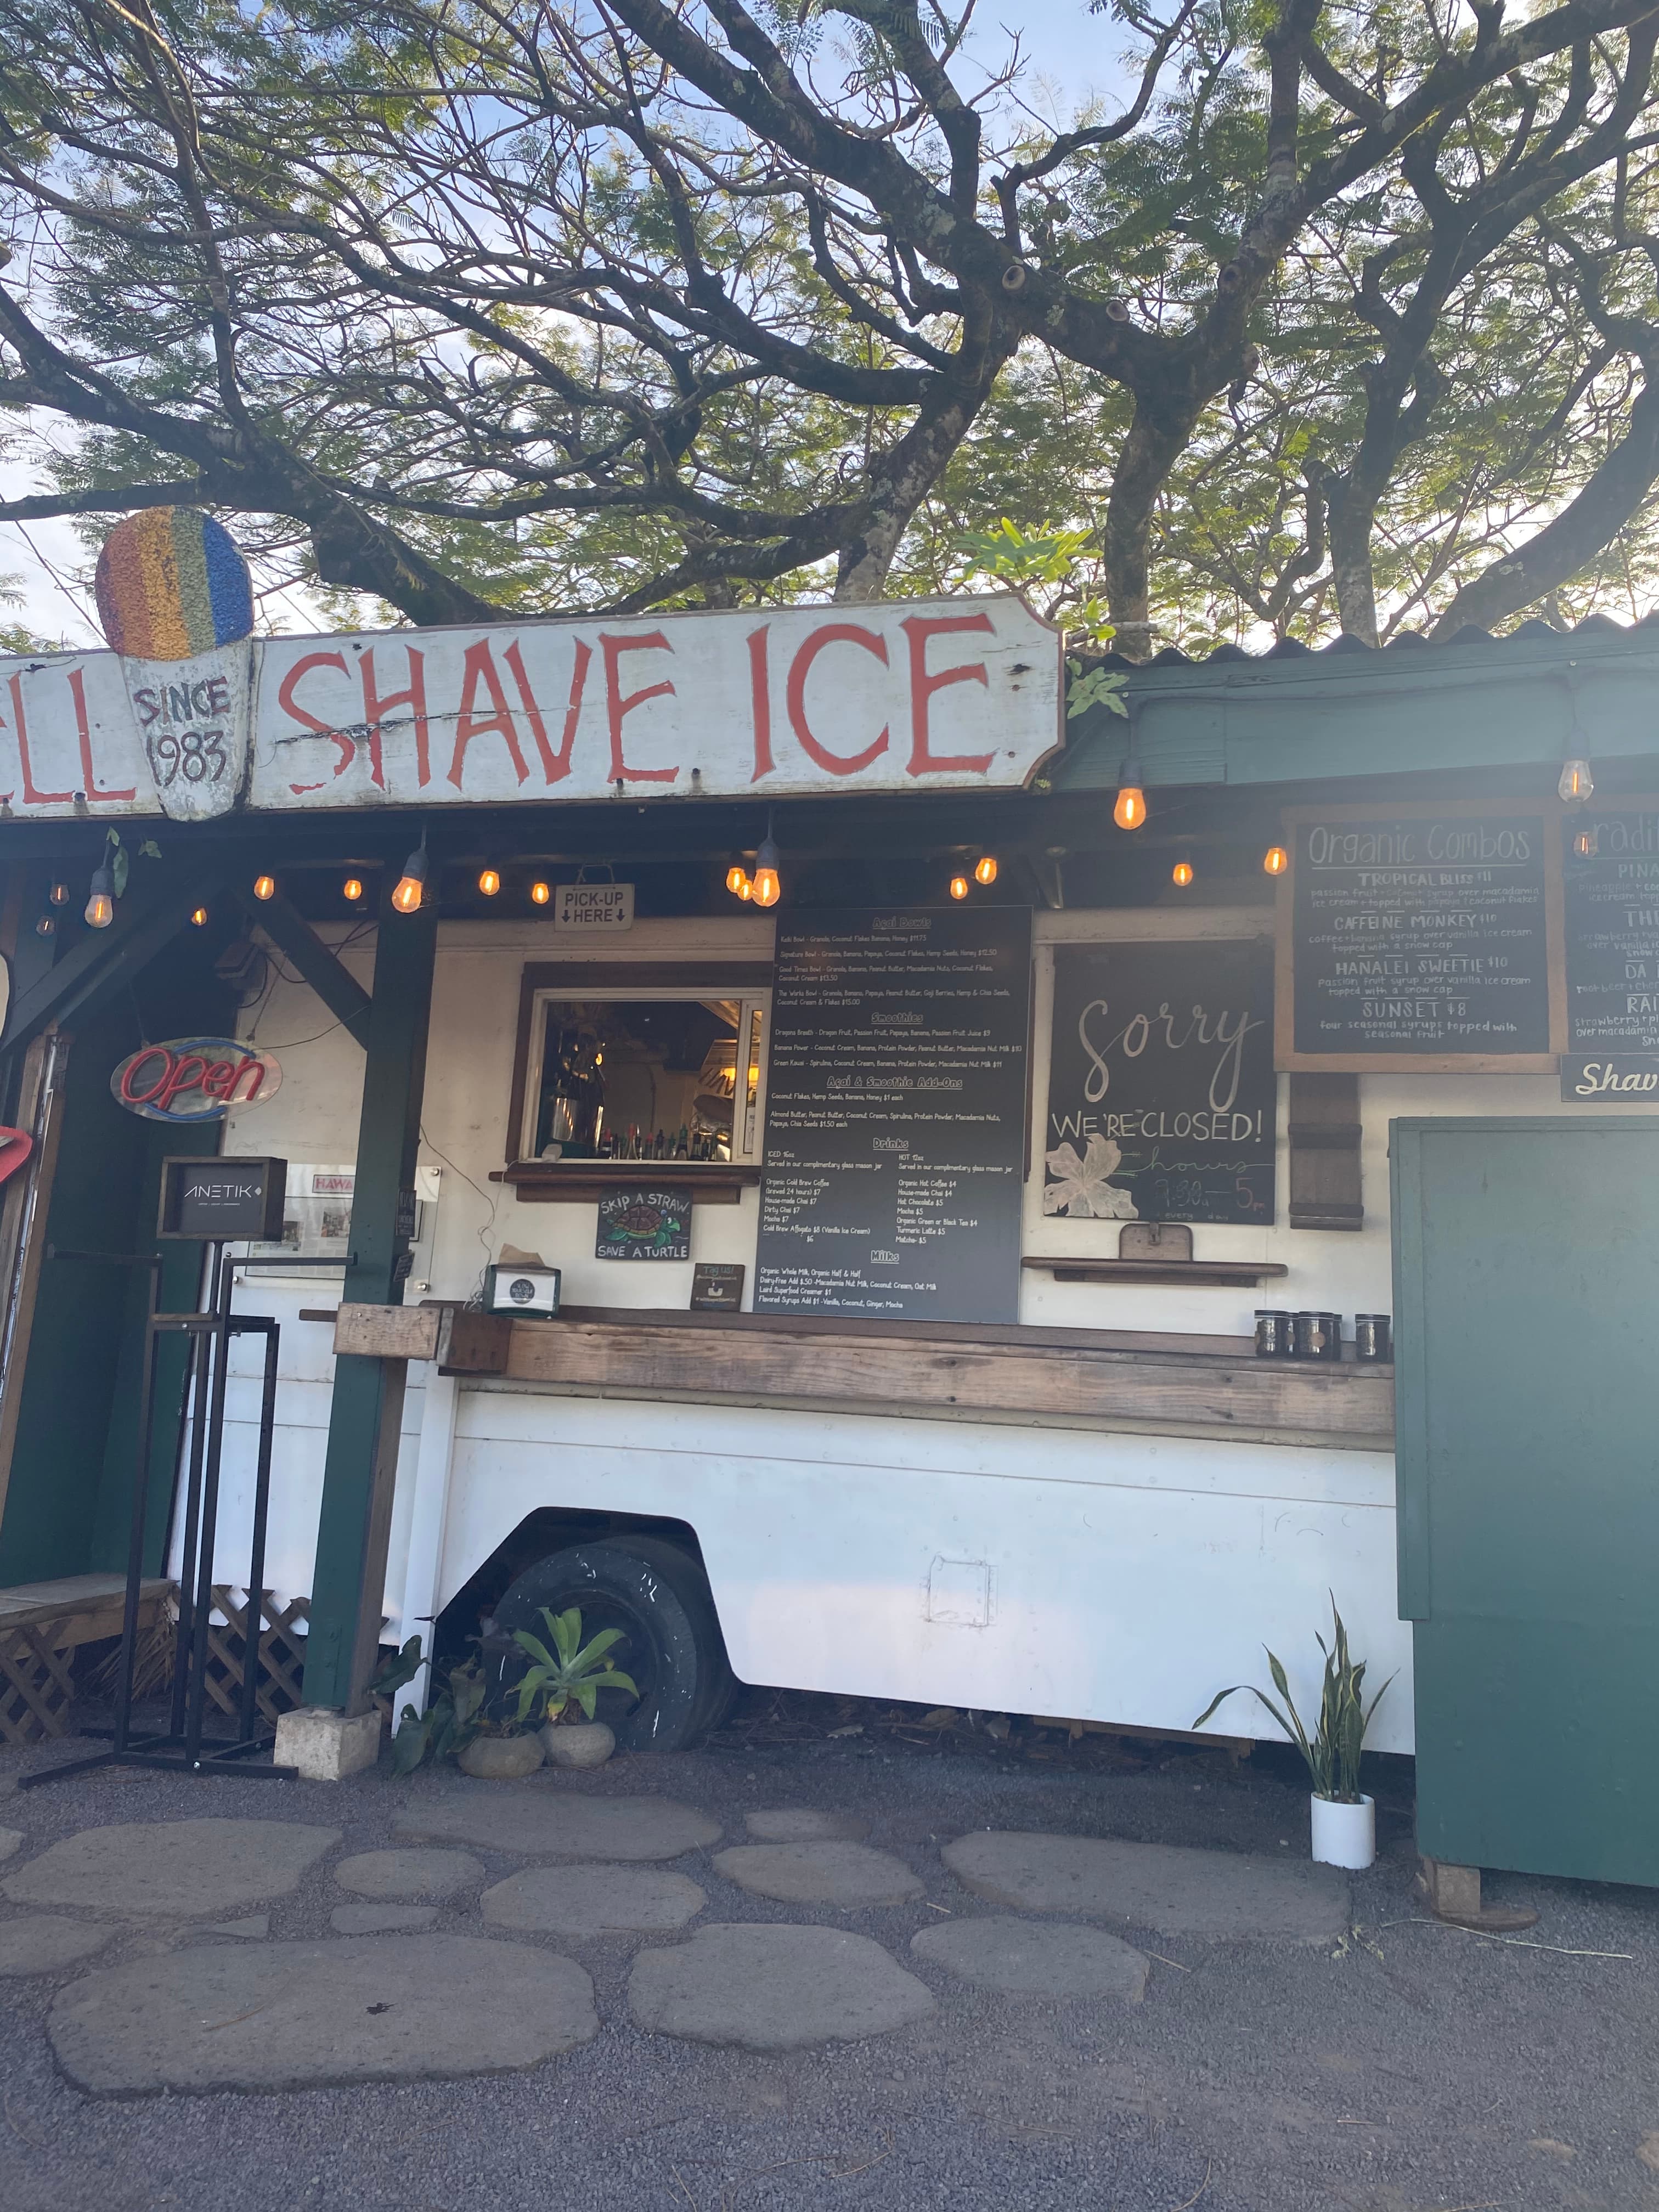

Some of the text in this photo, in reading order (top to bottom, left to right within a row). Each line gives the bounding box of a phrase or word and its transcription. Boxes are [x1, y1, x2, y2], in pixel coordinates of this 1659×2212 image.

[133, 676, 231, 727] SINCE
[279, 612, 999, 795] SHAVE ICE
[0, 665, 137, 805] LL
[145, 731, 227, 787] 1983
[1308, 825, 1531, 865] Organic Combos
[1357, 872, 1437, 887] TROPICAL
[1439, 873, 1474, 885] BLISS
[565, 891, 624, 907] PICK-UP
[1311, 888, 1349, 899] passion
[1352, 888, 1379, 897] fruit
[1458, 889, 1480, 898] over
[1482, 887, 1540, 898] macadamia
[1311, 898, 1326, 908] ice
[1404, 897, 1425, 906] with
[1469, 896, 1506, 905] coconut
[574, 909, 613, 923] HERE
[1334, 915, 1403, 931] CAFFEINE
[1410, 915, 1477, 929] MONKEY
[1390, 933, 1420, 942] syrup
[1448, 930, 1480, 939] vanilla
[1483, 929, 1498, 937] ice
[1500, 928, 1532, 937] cream
[1331, 943, 1365, 953] topped
[1367, 942, 1389, 951] with
[1404, 941, 1430, 950] snow
[1432, 941, 1453, 951] cap
[1335, 956, 1508, 975] HANALEI SWEETIE $10
[1624, 964, 1646, 979] DA
[1318, 978, 1359, 988] passion
[1363, 976, 1386, 986] fruit
[1390, 977, 1419, 986] syrup
[1447, 975, 1482, 985] vanilla
[1484, 977, 1499, 985] ice
[1501, 977, 1531, 985] cream
[1328, 986, 1361, 997] topped
[1364, 986, 1387, 995] with
[1434, 986, 1453, 996] cap
[1362, 1001, 1466, 1018] SUNSET $8
[871, 1011, 923, 1023] Smoothies
[1575, 1016, 1640, 1027] strawberry
[1319, 1020, 1517, 1033] four seasonal syrups topped with
[1576, 1025, 1657, 1037] over macadamia
[1364, 1030, 1412, 1039] seasonal
[1079, 999, 1265, 1113] Sorry
[120, 1047, 266, 1110] Open
[854, 1076, 863, 1087] &
[866, 1076, 913, 1087] Smoothie
[917, 1076, 963, 1088] Add-Ons
[1575, 1063, 1659, 1096] Shav
[1051, 1109, 1262, 1143] WE'RE CLOSED!
[873, 1137, 909, 1149] Drinks
[803, 1160, 840, 1170] complimentary
[841, 1161, 854, 1170] glass
[873, 1163, 883, 1171] jar
[1141, 1146, 1256, 1173] hours
[766, 1178, 785, 1187] Organic
[813, 1178, 830, 1188] Coffee
[898, 1179, 918, 1188] Organic
[930, 1179, 947, 1188] Coffee
[949, 1180, 957, 1188] $4
[184, 1184, 252, 1198] ANETIK
[600, 1193, 690, 1214] SKIP A STRAW
[764, 1206, 778, 1215] Dirty
[793, 1206, 800, 1215] $7
[1164, 1211, 1229, 1221] every day
[781, 1215, 789, 1223] $7
[597, 1245, 688, 1258] SAVE A TURTLE
[871, 1249, 900, 1262] Milks
[703, 1266, 719, 1277] Tag
